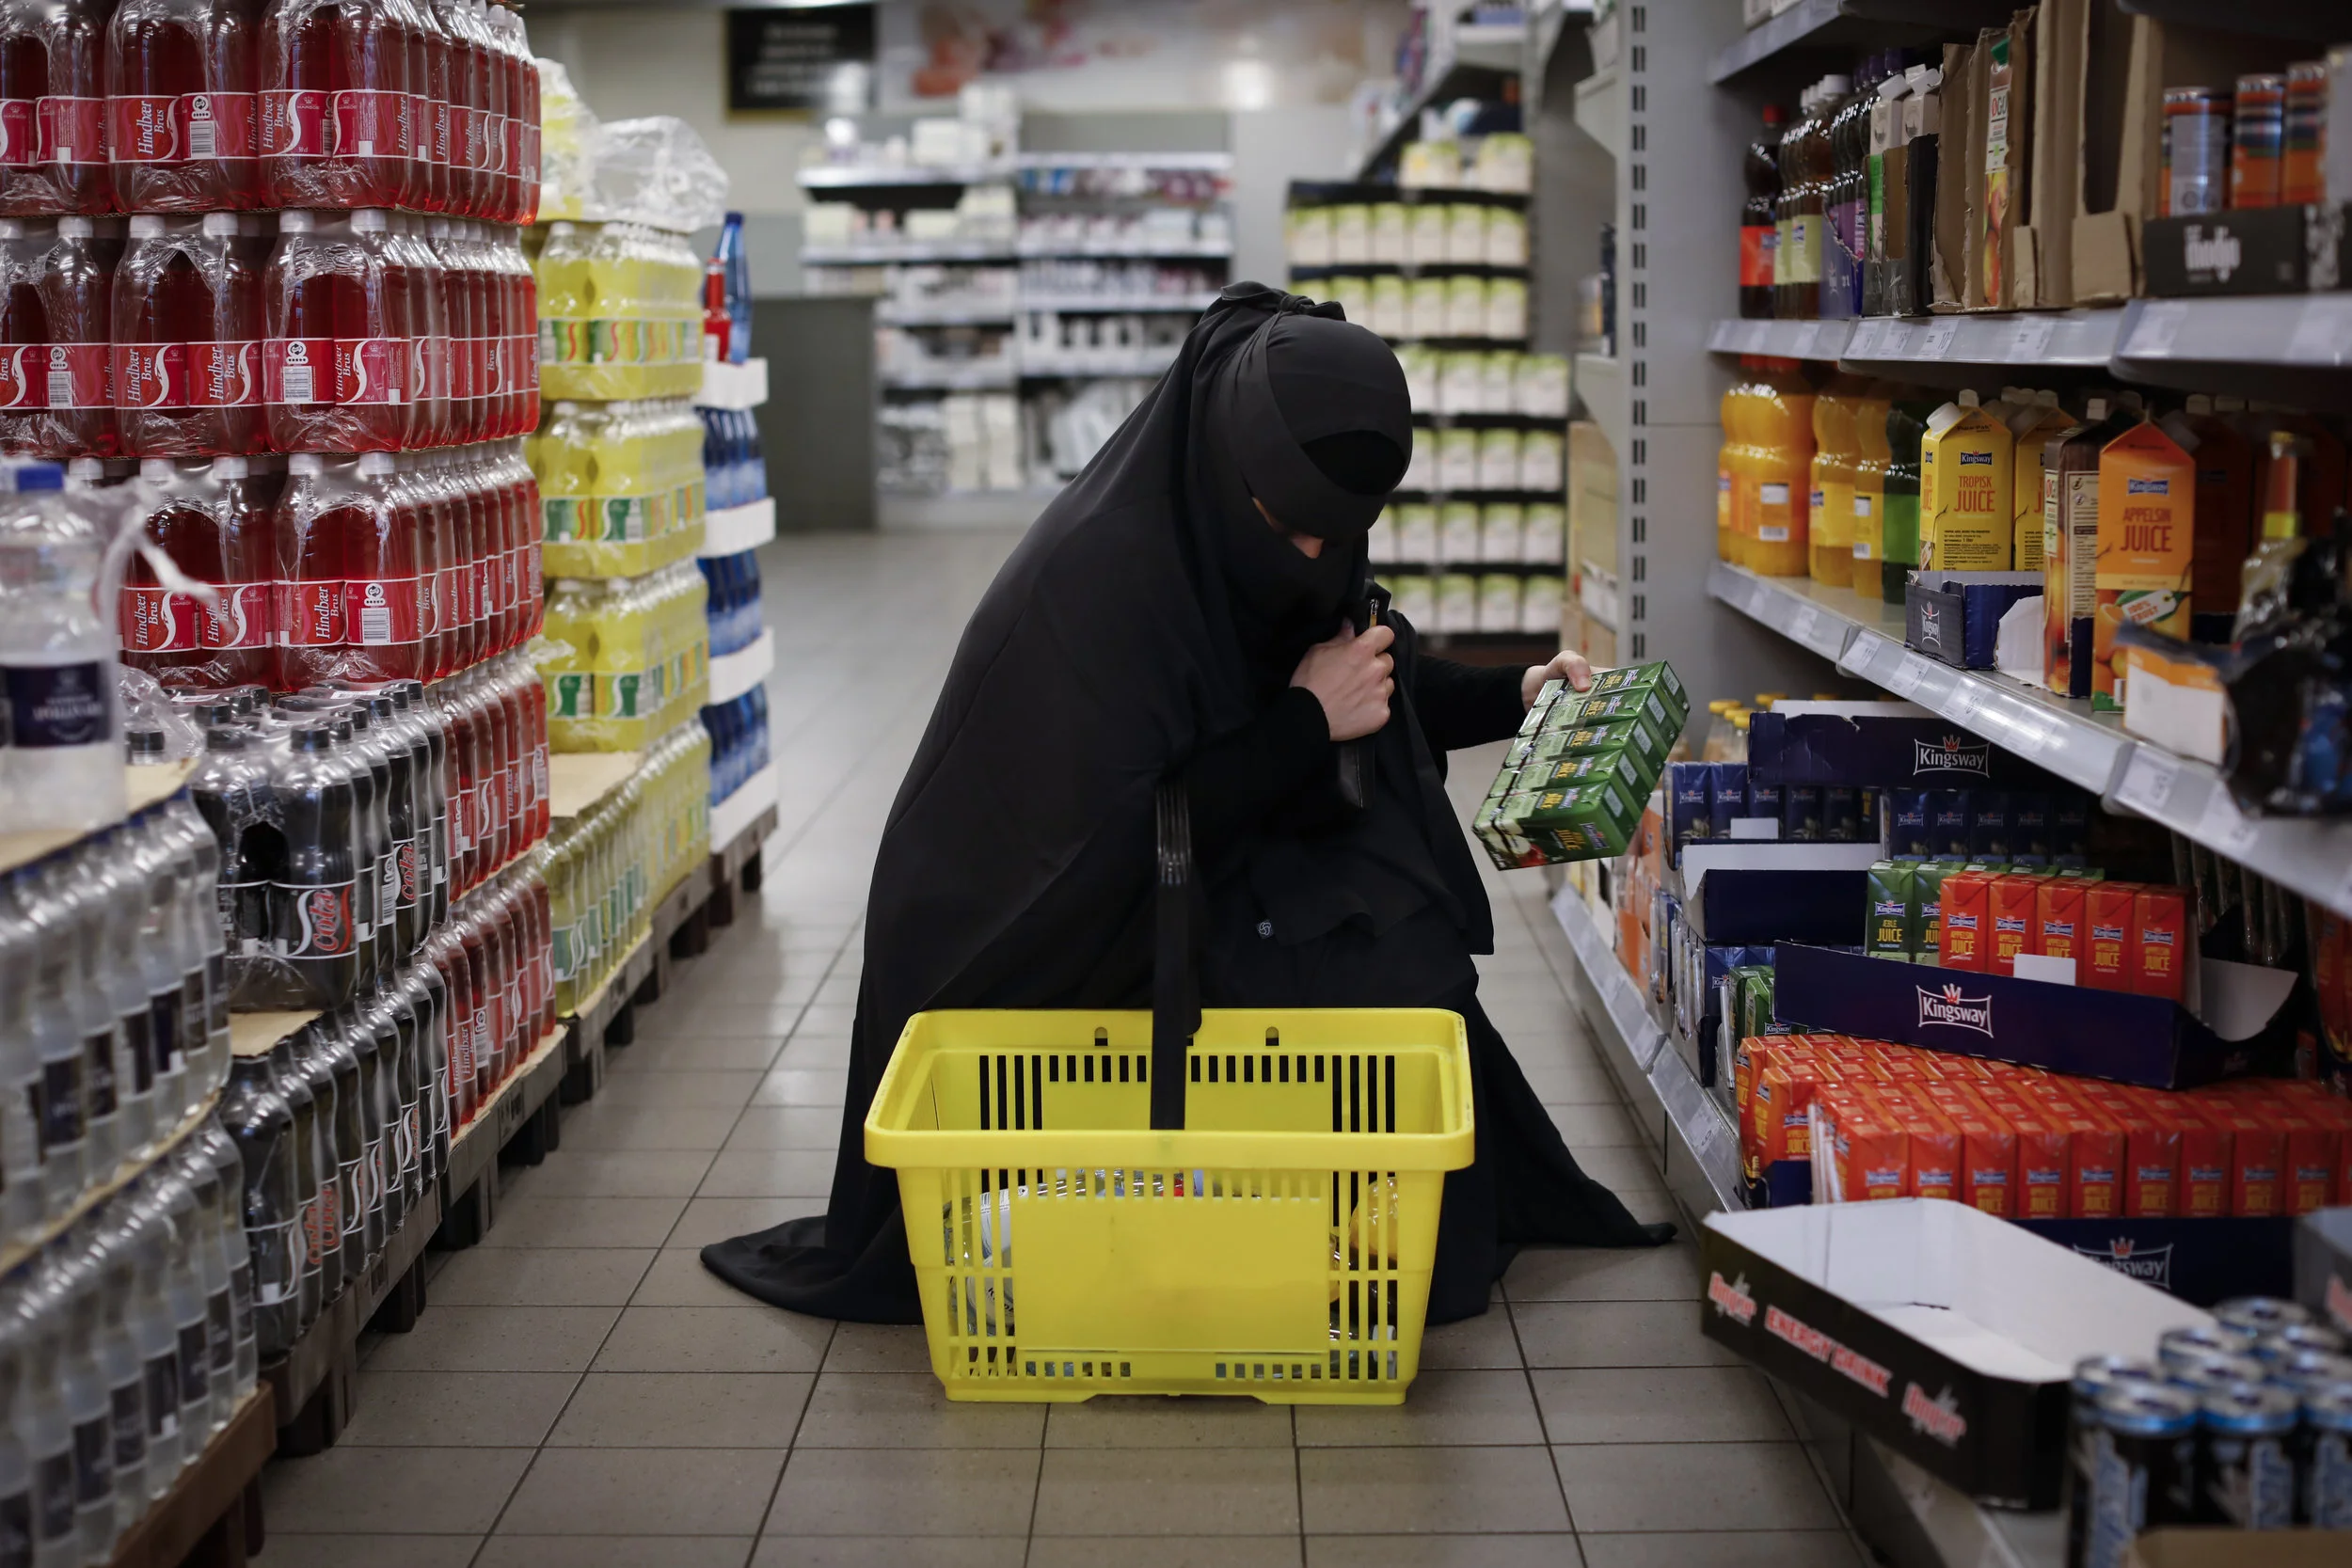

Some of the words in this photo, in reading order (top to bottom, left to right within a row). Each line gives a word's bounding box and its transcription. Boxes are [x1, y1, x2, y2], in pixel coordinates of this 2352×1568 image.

[154, 109, 165, 134] Brus
[262, 95, 276, 150] Hindbær
[274, 103, 283, 128] Brus
[136, 101, 153, 155] Hindbær
[141, 357, 152, 381] Brus
[224, 355, 235, 379] Brus
[487, 350, 496, 372] Brus
[126, 349, 141, 402] Hindbær
[207, 347, 224, 400] Hindbær
[1962, 453, 1992, 463] Kingsway
[1959, 476, 1992, 488] TROPISK
[1954, 491, 1995, 512] JUICE
[2123, 507, 2172, 523] APPELSIN
[2121, 526, 2172, 552] JUICE
[148, 601, 158, 626] Brus
[314, 586, 329, 639] Hindbær
[330, 594, 340, 617] Brus
[135, 594, 149, 646] Hindbær
[1923, 616, 1939, 638] Kingsway
[1920, 748, 1985, 768] Kingsway
[310, 889, 339, 951] Cola
[1877, 905, 1904, 914] Kingsway
[1883, 919, 1898, 928] ÆBLE
[1877, 928, 1903, 942] JUICE
[1923, 929, 1939, 943] JUI
[1949, 941, 1975, 955] JUICE
[1996, 943, 2023, 958] JUICE
[2046, 947, 2072, 958] JUICE
[2094, 952, 2121, 967] JUICE
[2143, 956, 2170, 971] JUICE
[1923, 996, 1987, 1026] Kingsway
[1766, 1025, 1790, 1034] Kingsway
[1764, 1304, 1834, 1364] ENERGY
[1831, 1339, 1894, 1399] DRINK
